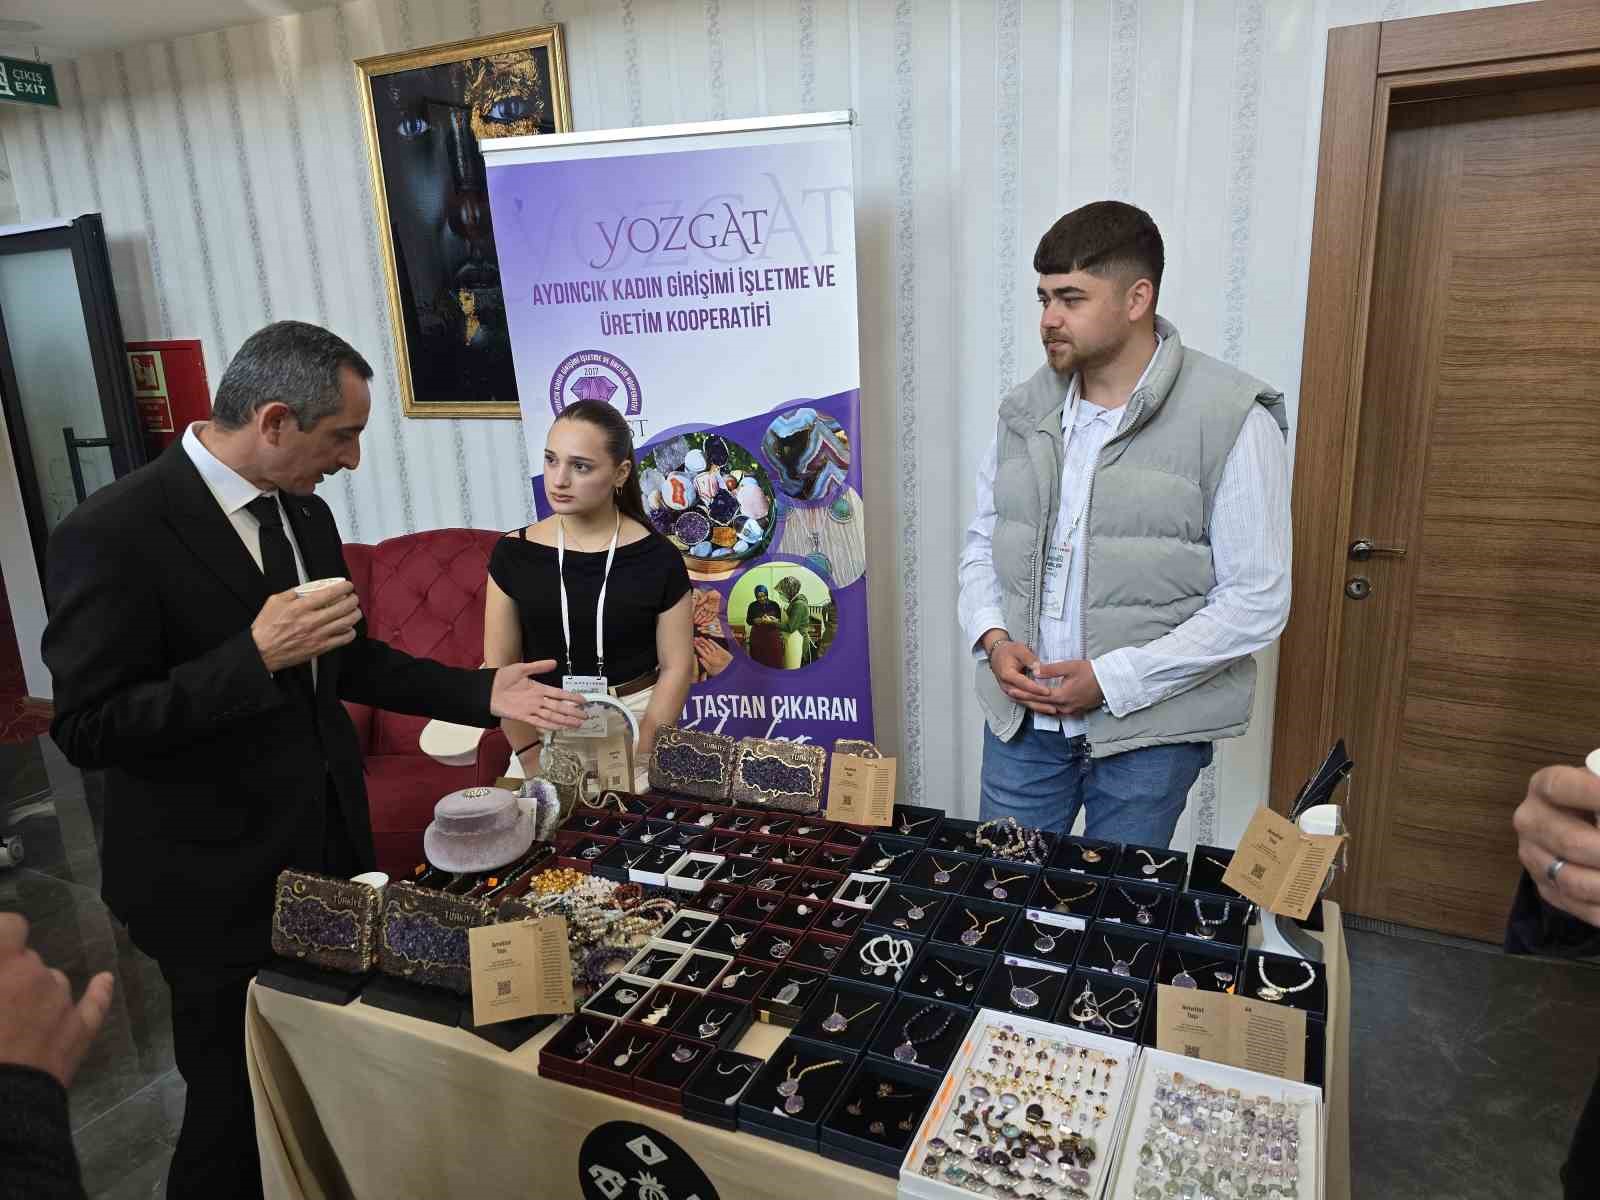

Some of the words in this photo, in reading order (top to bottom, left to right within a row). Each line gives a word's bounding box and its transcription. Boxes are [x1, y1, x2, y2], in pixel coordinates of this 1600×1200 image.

[15, 81, 47, 95] EXIT
[589, 203, 768, 269] YOZGAT
[533, 279, 609, 306] AYDINCIK
[611, 275, 663, 301] KADIN
[666, 267, 735, 300] GİRİŞİMİ
[738, 265, 811, 297] İŞLETME
[813, 264, 837, 288] VE
[600, 308, 663, 336] ÜRETİM
[666, 300, 772, 333] KOOPERATİFİ
[584, 367, 599, 376] 2017
[691, 694, 766, 719] TAŞTAN
[771, 695, 858, 723] ÇIKARAN
